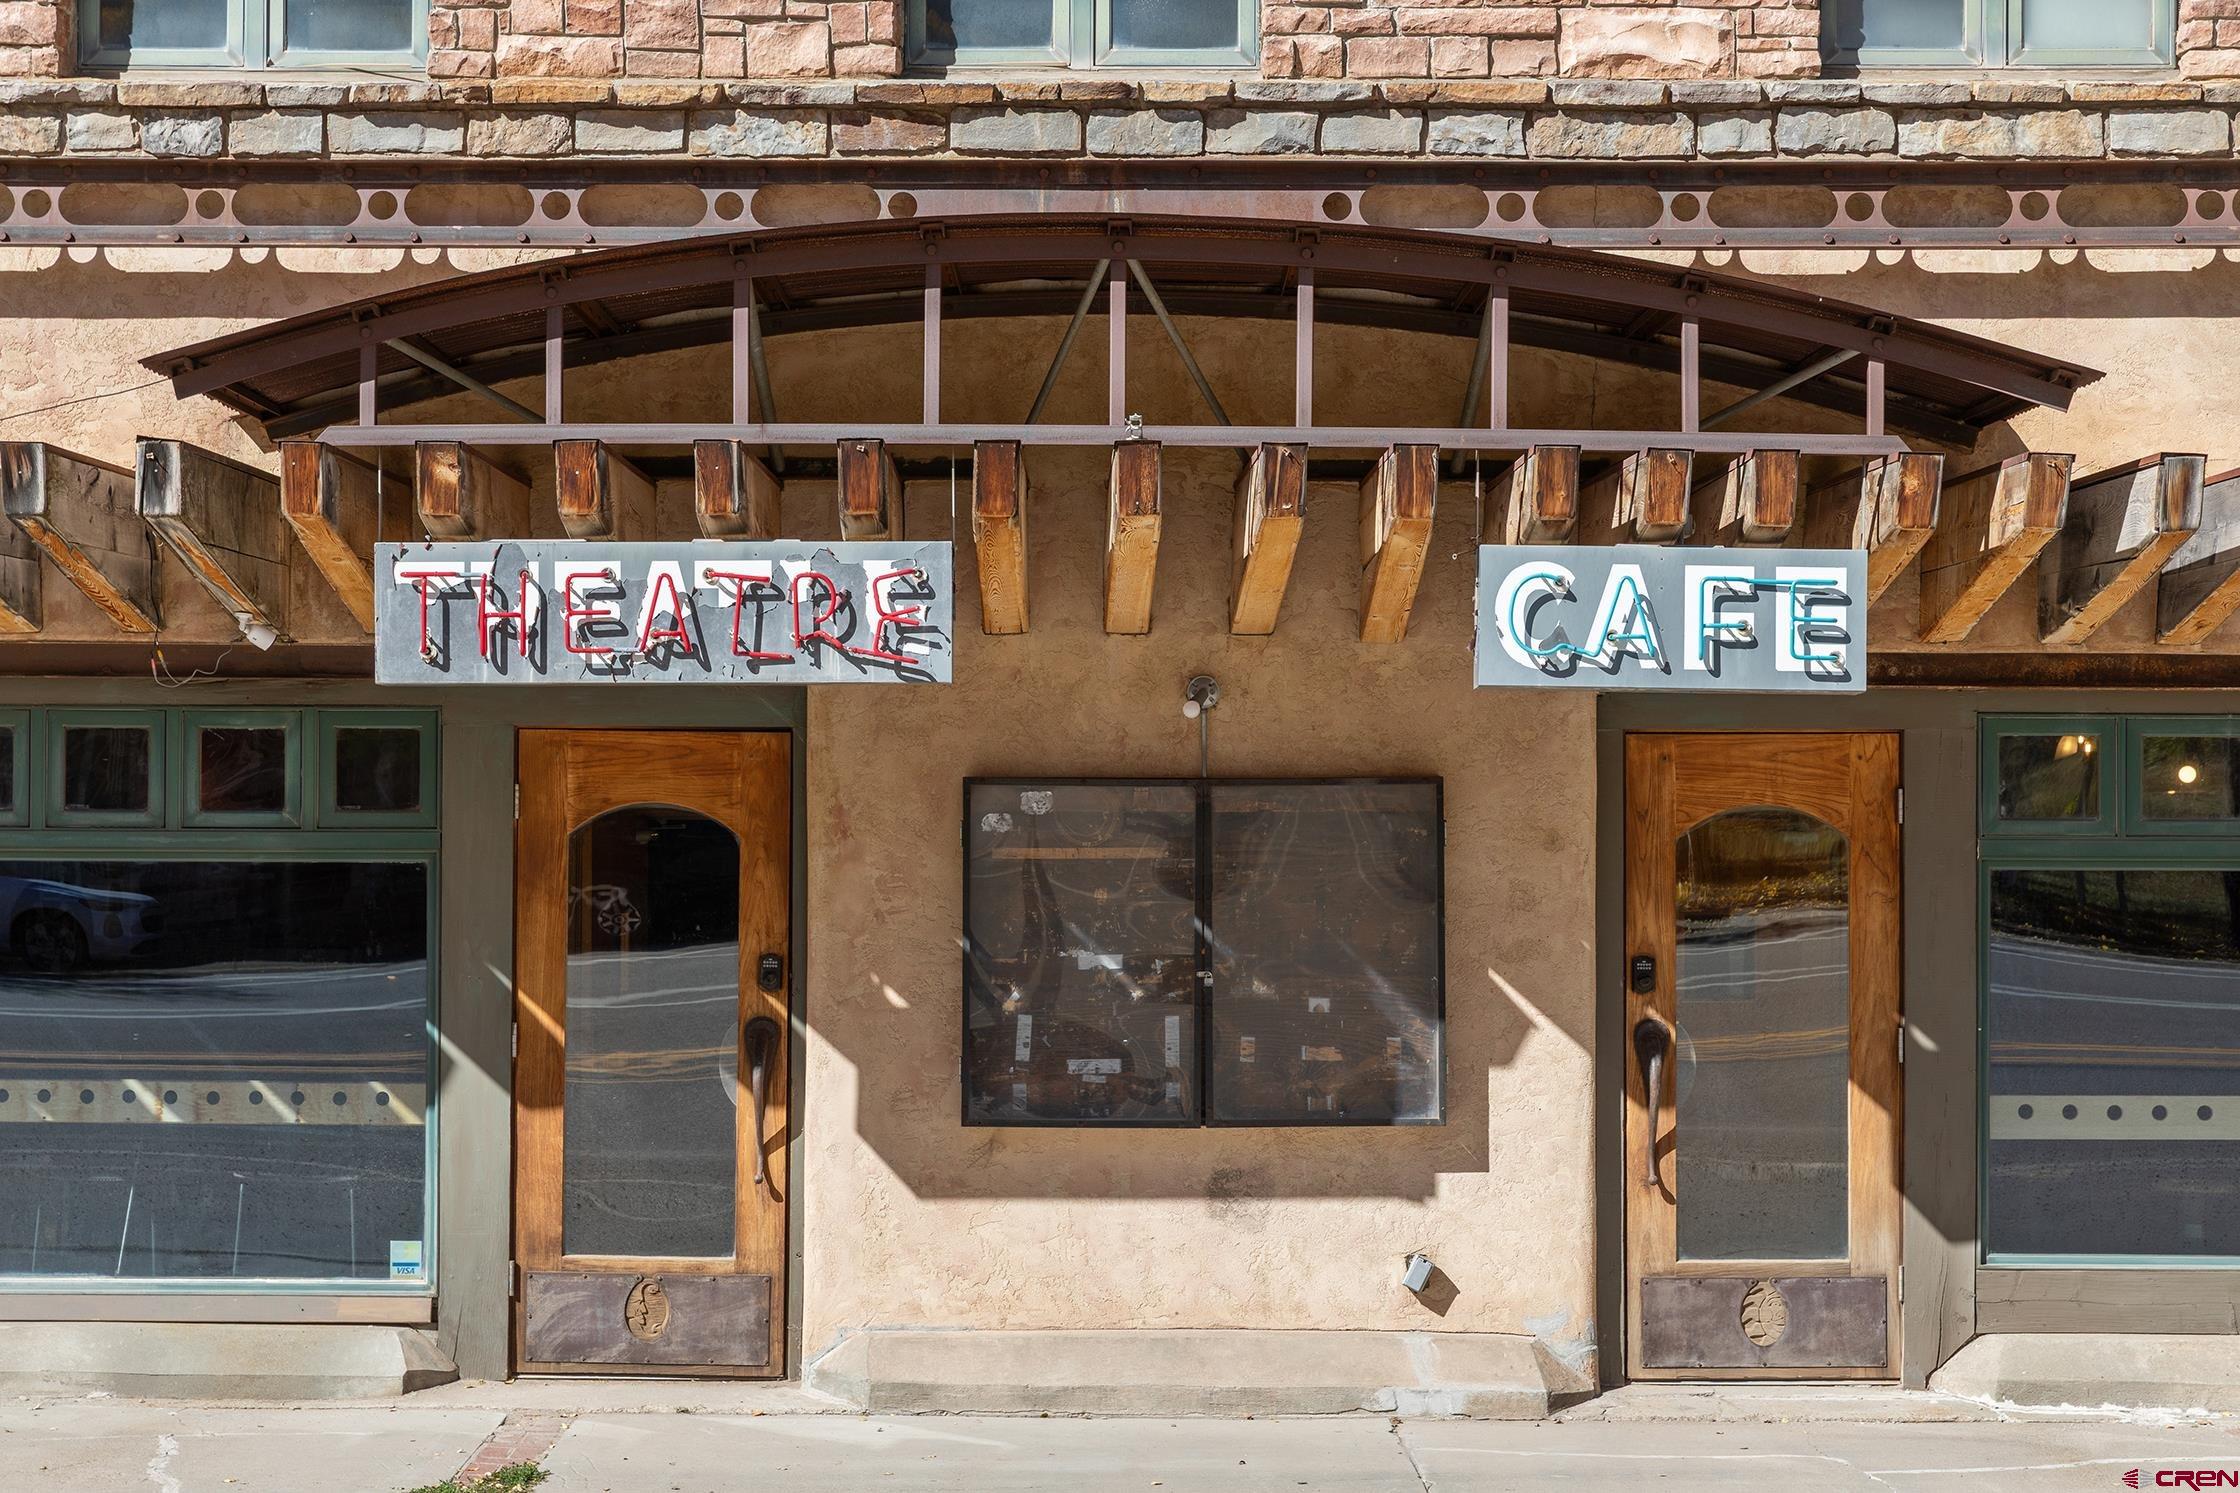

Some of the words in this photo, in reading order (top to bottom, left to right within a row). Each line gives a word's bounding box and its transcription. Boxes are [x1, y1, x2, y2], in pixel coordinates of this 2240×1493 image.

[394, 560, 931, 665] THEATRE
[1495, 561, 1848, 672] CAFE
[396, 1267, 415, 1275] VISA
